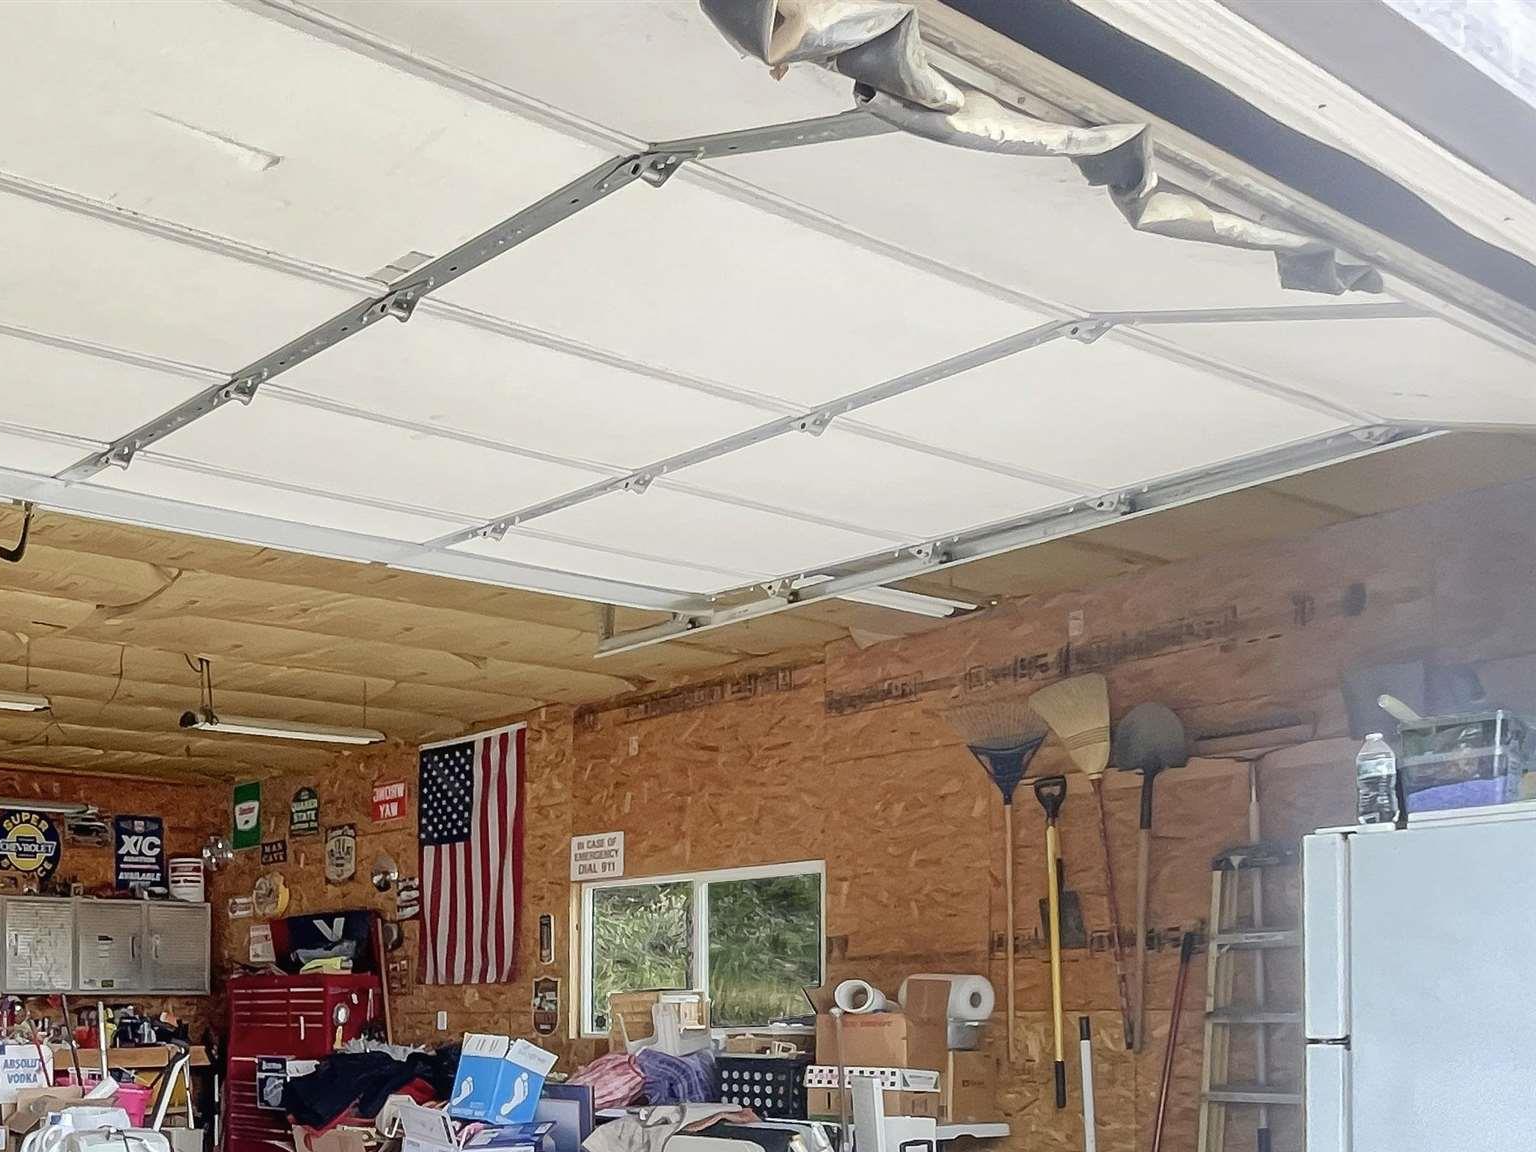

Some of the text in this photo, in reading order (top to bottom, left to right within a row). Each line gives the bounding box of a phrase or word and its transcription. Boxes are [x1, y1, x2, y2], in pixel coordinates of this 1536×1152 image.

[3, 812, 49, 832] SUPER
[574, 849, 618, 861] EMERGENCY
[578, 864, 598, 874] DIAL
[7, 1074, 38, 1084] VODKA
